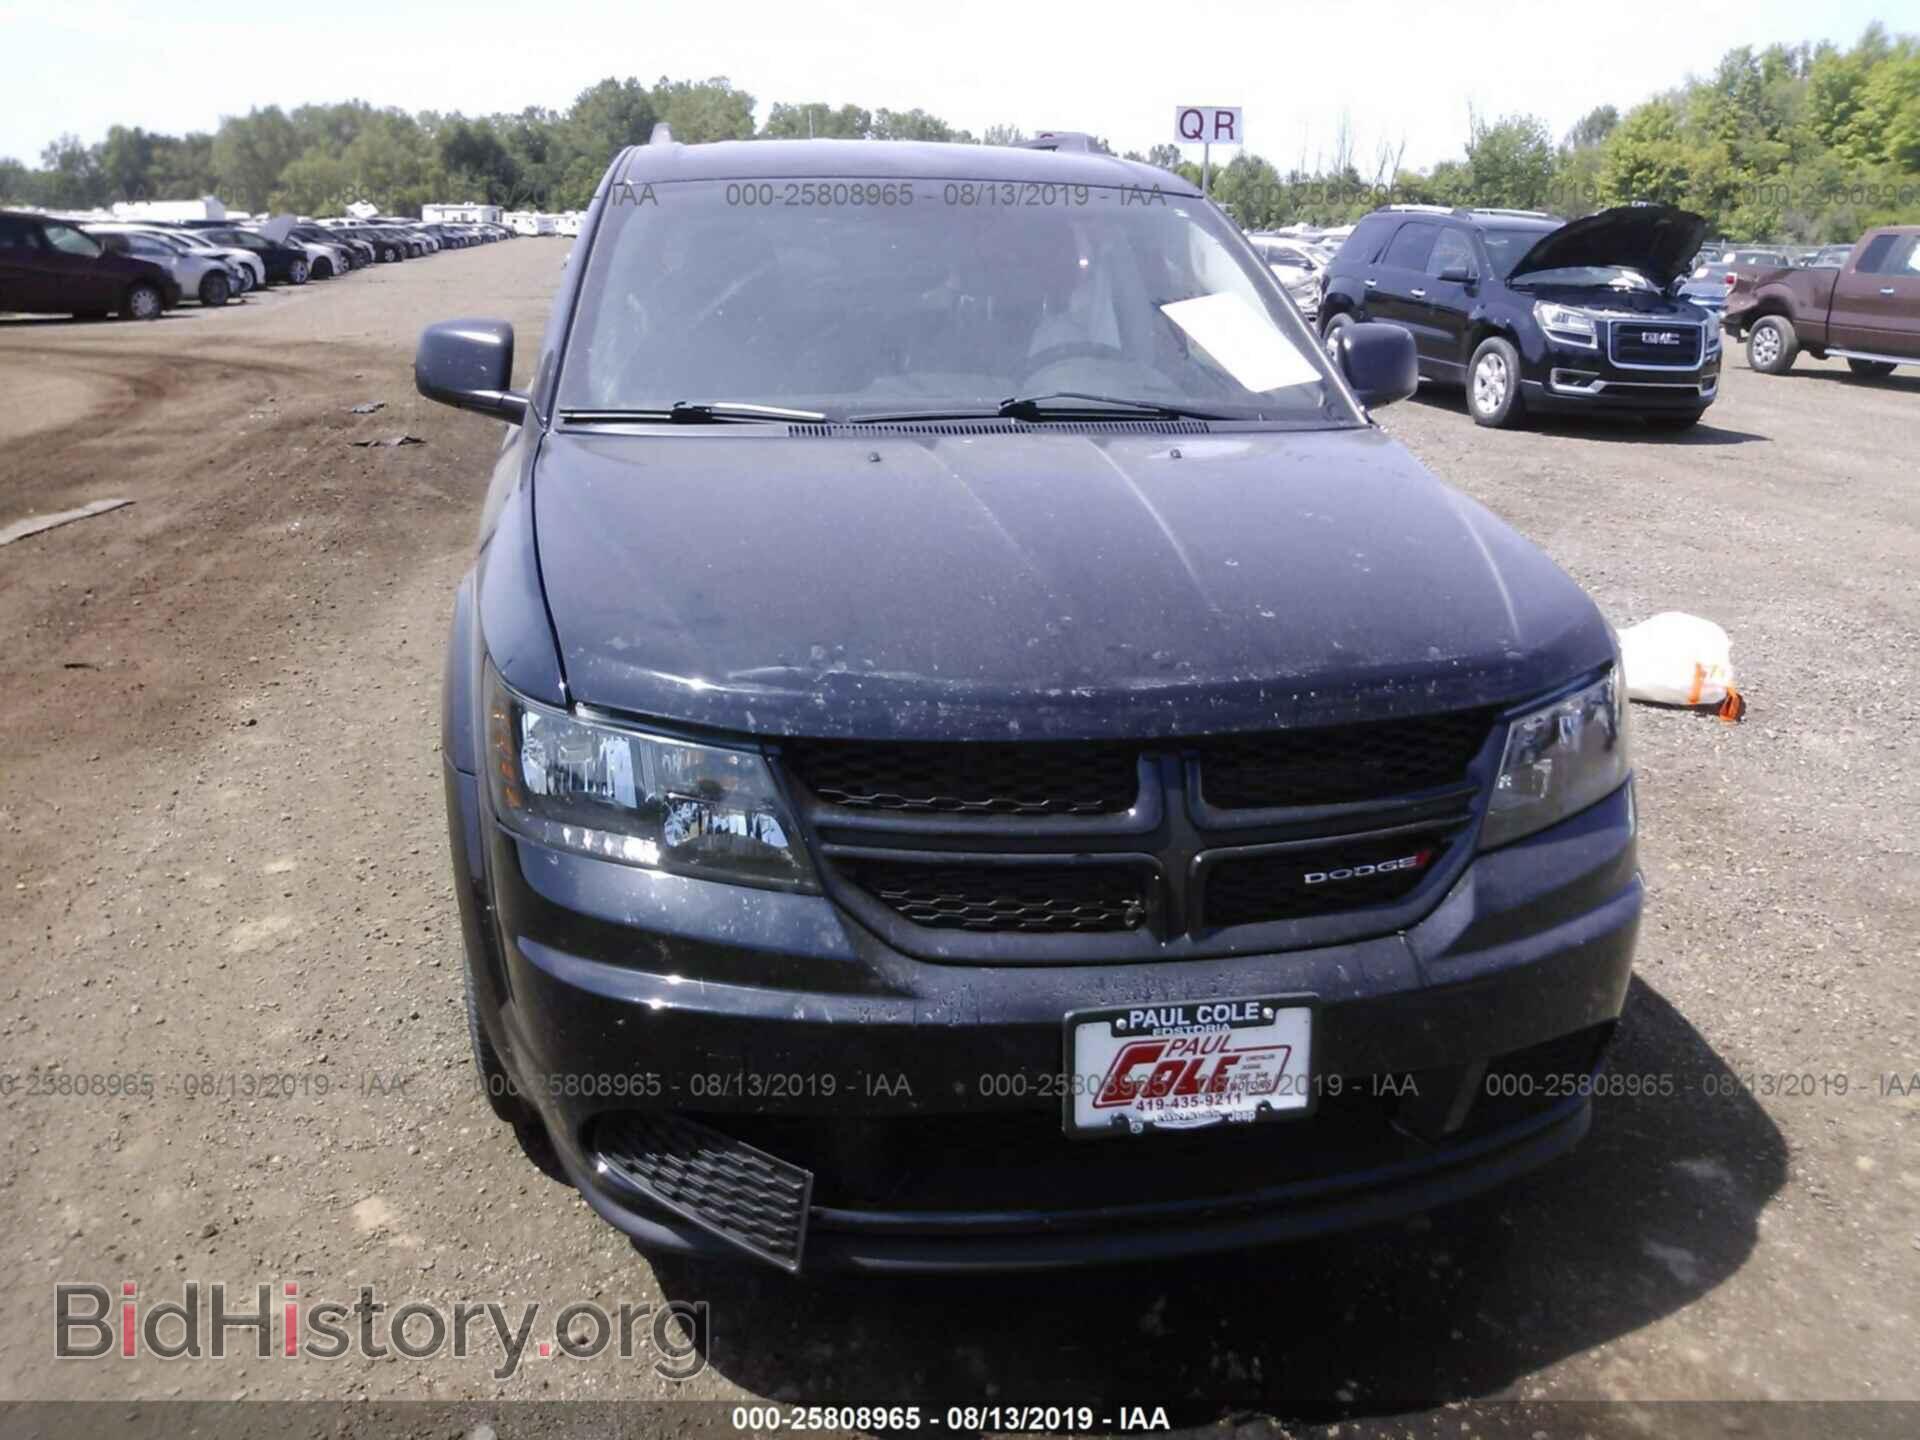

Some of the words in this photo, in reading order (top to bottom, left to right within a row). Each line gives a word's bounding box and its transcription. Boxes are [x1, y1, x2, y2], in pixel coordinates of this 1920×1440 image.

[1304, 856, 1417, 884] DODGE
[1129, 1008, 1190, 1029] PAUL
[1196, 1002, 1260, 1024] COLE
[1165, 1034, 1233, 1057] PAUL
[1101, 1044, 1241, 1102] COLE
[1136, 1092, 1242, 1112] 419-435-9211
